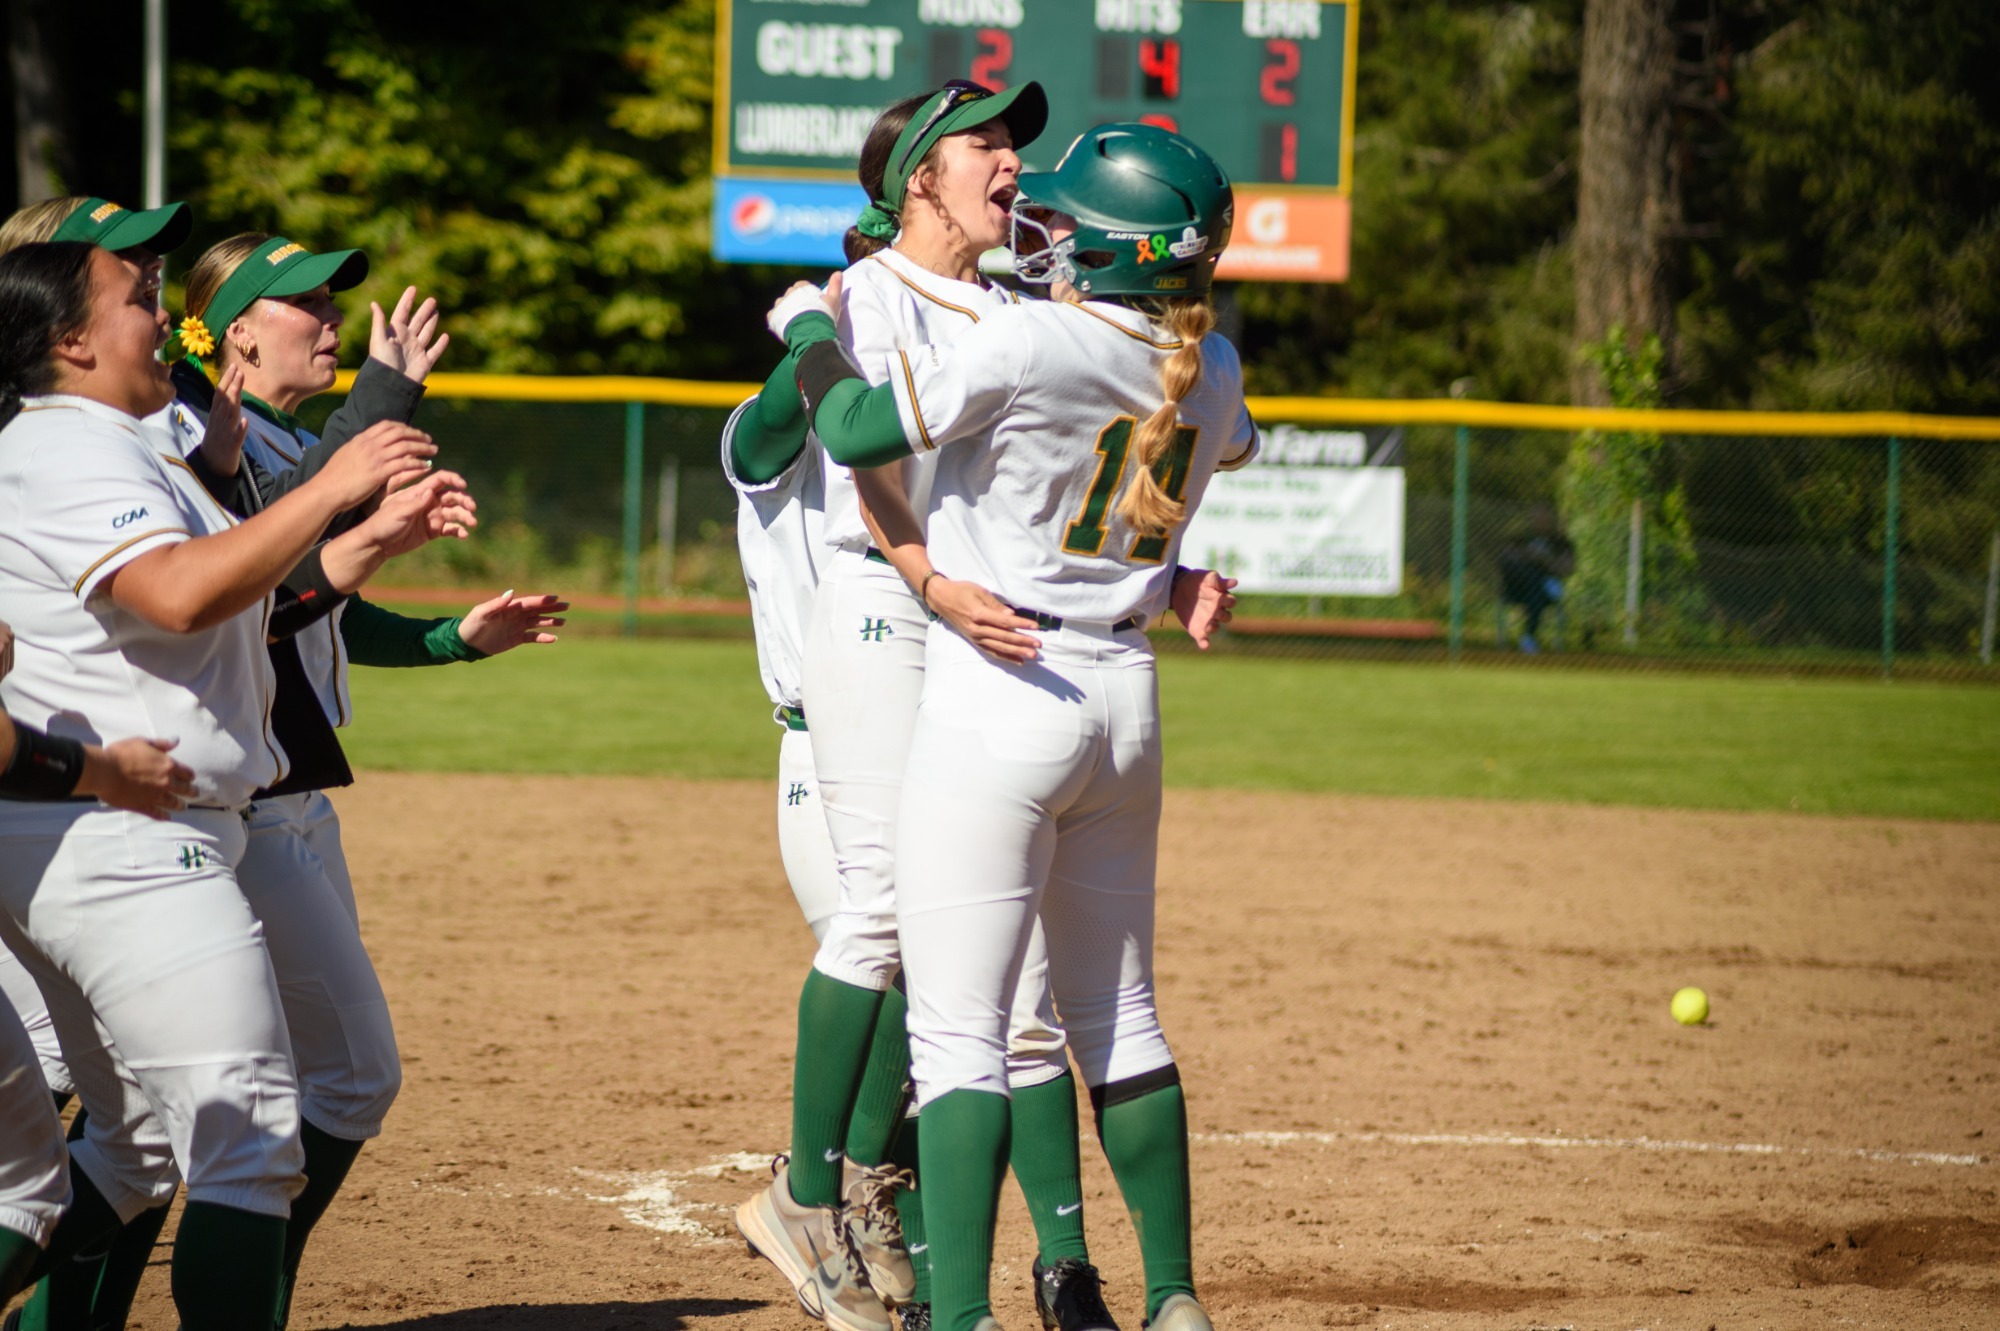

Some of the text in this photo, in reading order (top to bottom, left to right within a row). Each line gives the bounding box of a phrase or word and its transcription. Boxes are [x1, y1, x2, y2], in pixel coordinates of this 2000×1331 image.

[1242, 0, 1321, 39] ERR
[757, 20, 902, 80] GUEST
[1138, 38, 1180, 98] 4
[1260, 38, 1299, 106] 2
[1106, 232, 1149, 240] EASTON
